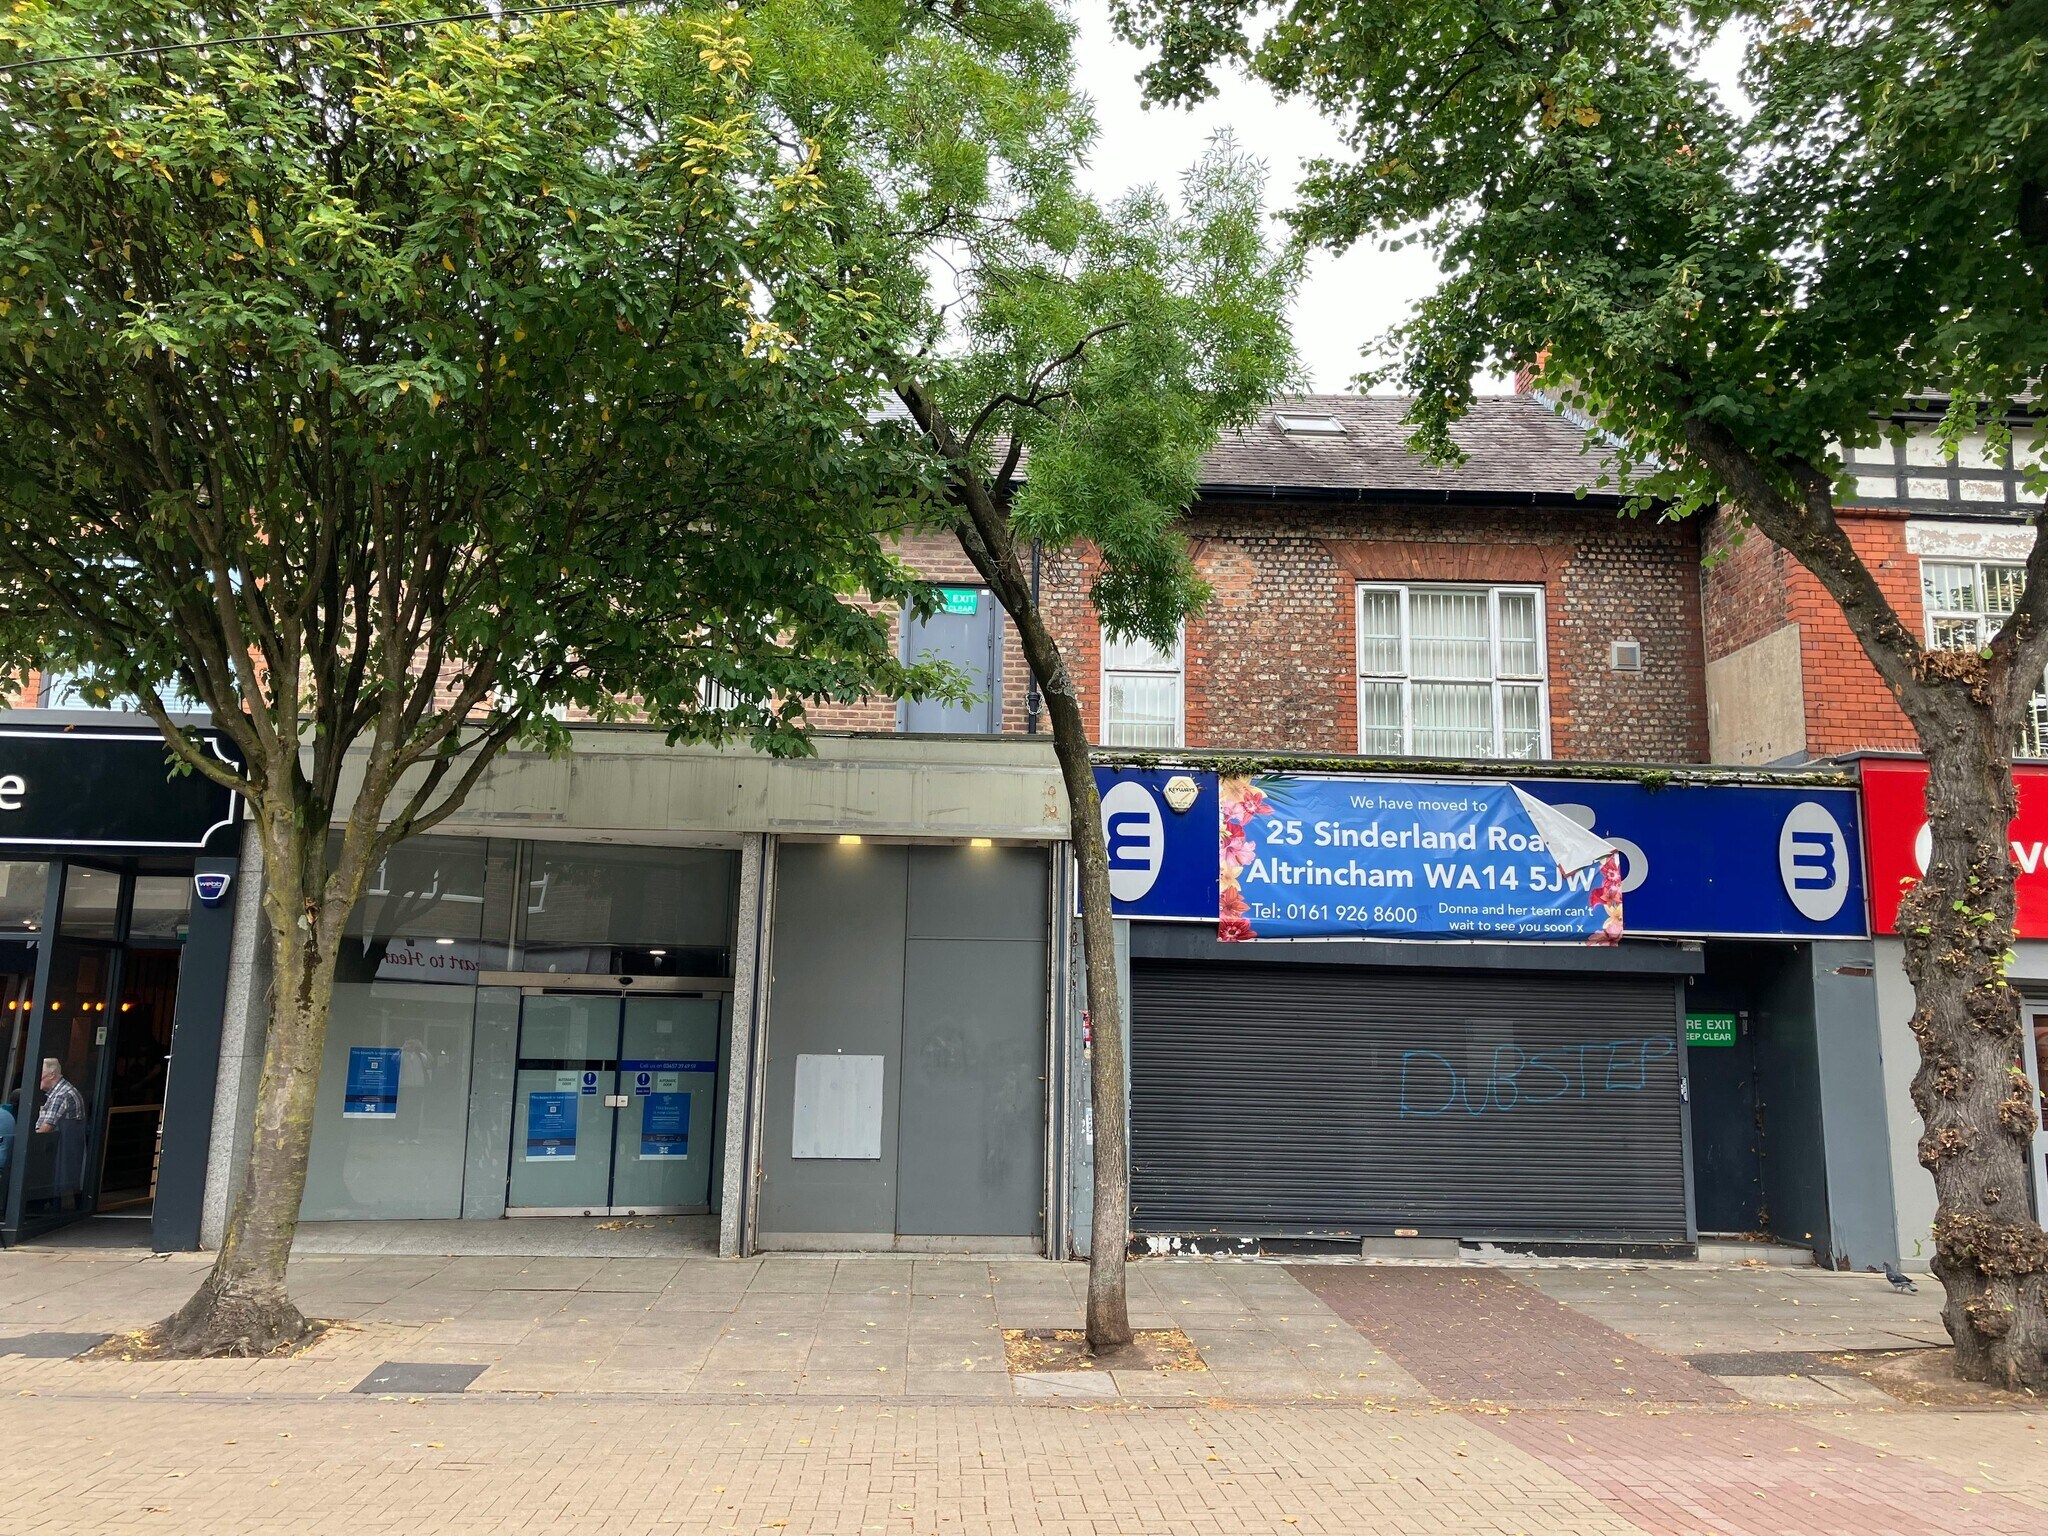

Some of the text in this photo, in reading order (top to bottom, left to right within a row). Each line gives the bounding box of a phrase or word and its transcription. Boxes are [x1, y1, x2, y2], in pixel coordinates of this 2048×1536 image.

[953, 594, 975, 603] EXIT
[1350, 795, 1488, 812] We have moved to
[1266, 820, 1545, 852] 25 Sinderland Roa
[2011, 841, 2048, 874] v
[1246, 857, 1596, 892] Altrincham WA14 5JW
[1251, 903, 1417, 924] Tel: 0161 926 8600
[1438, 903, 1594, 917] Donna and her team can't
[1449, 920, 1584, 934] wait to see you soon x
[1706, 1020, 1733, 1030] EXIT
